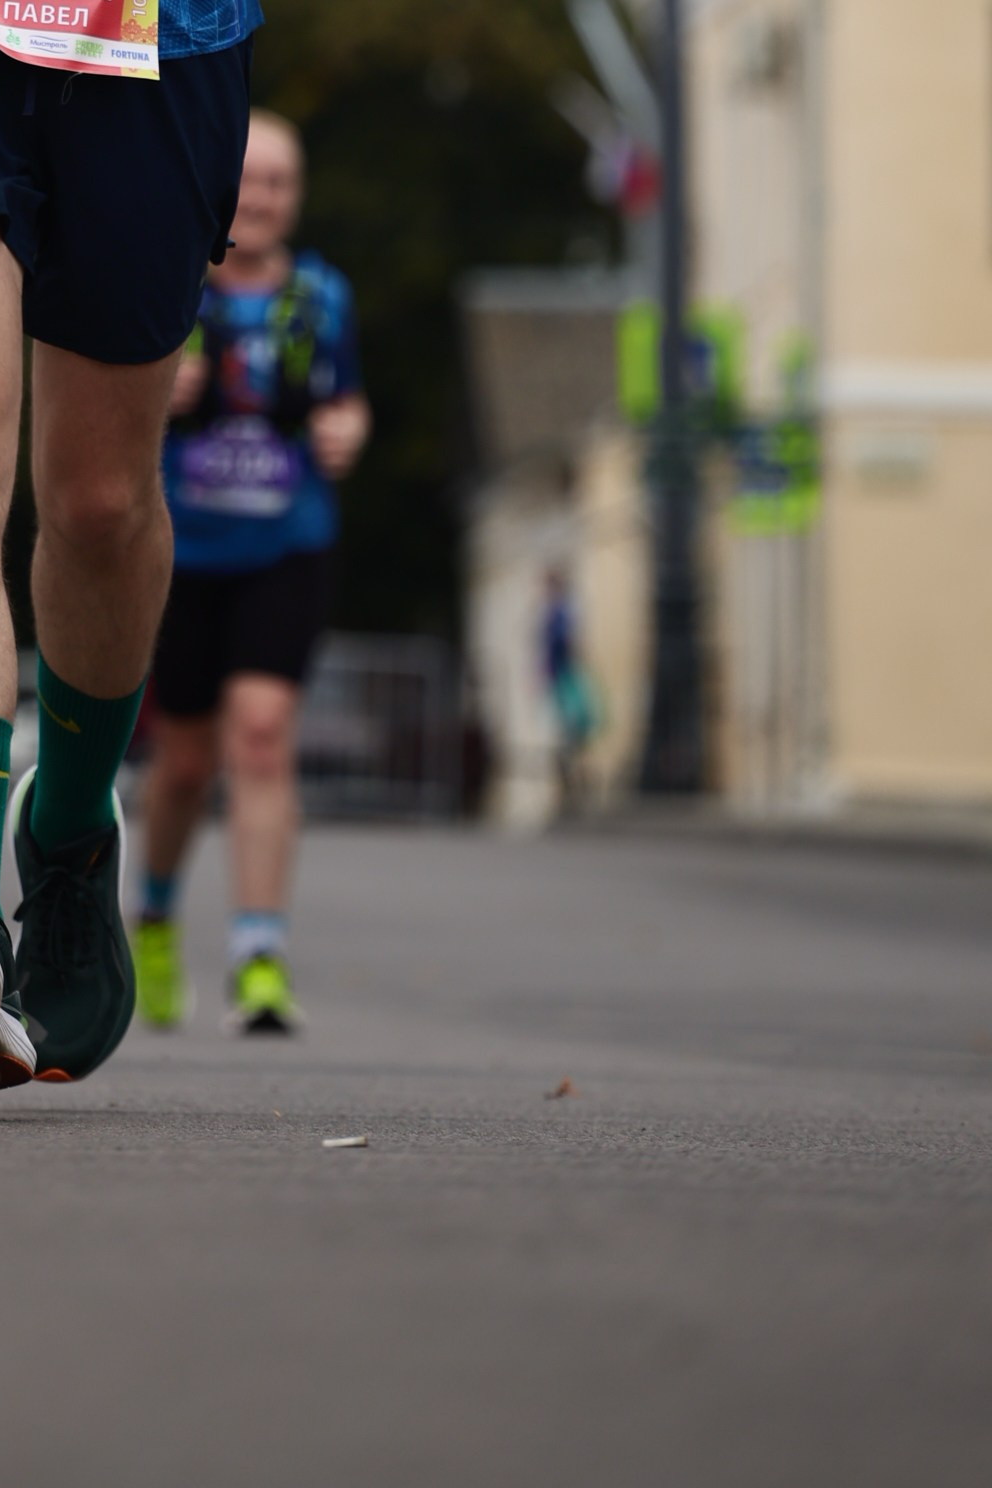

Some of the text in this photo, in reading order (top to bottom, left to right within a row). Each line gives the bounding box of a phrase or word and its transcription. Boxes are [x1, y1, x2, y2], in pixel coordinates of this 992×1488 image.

[3, 1, 89, 27] ПАВЕЛ
[29, 38, 68, 50] Мистраль
[111, 49, 150, 61] FORTUNA
